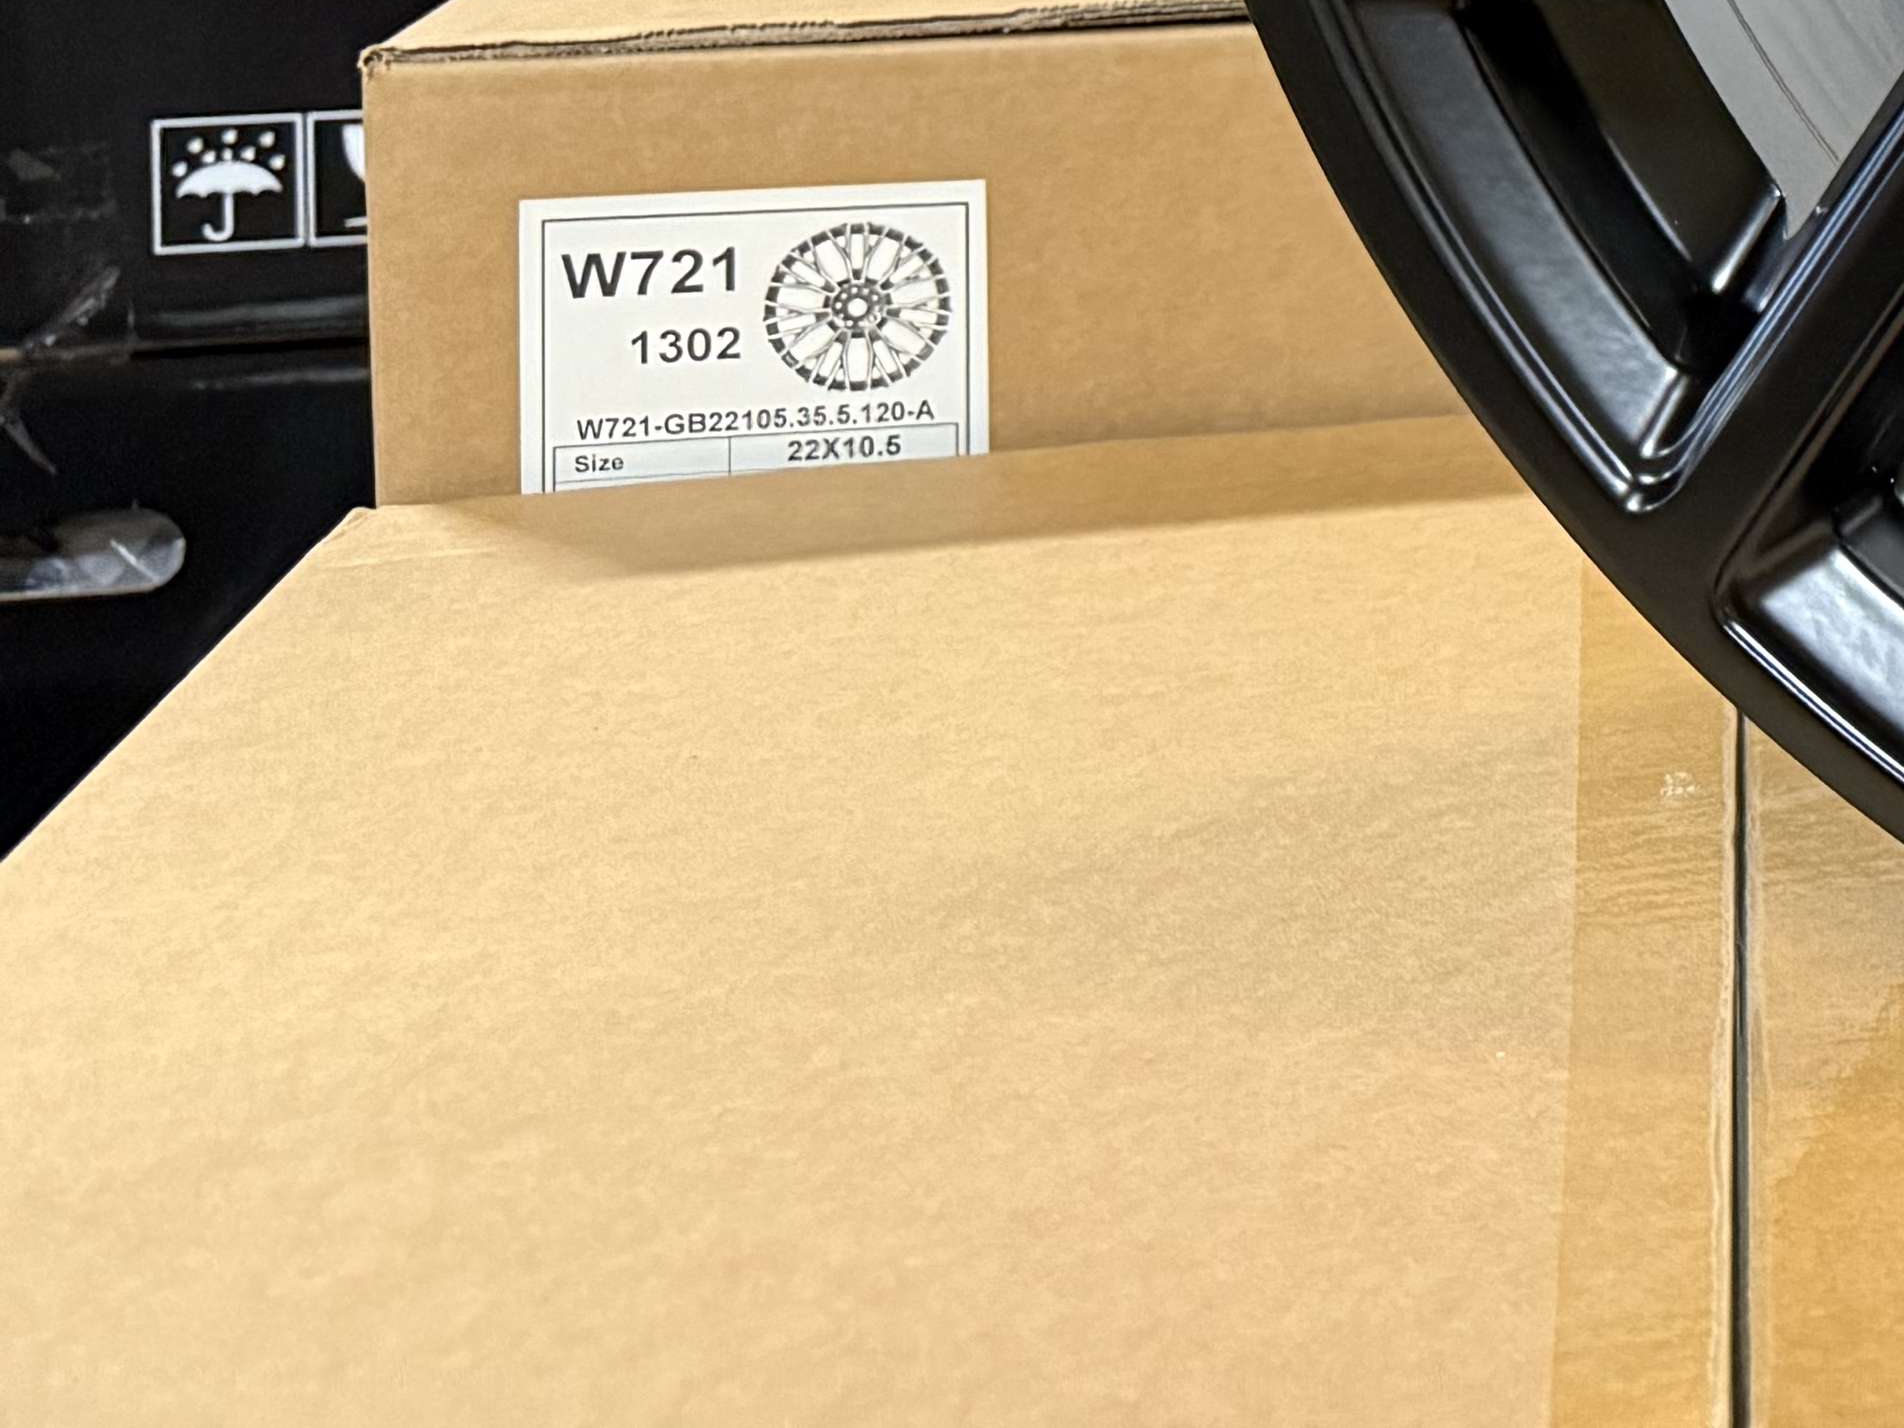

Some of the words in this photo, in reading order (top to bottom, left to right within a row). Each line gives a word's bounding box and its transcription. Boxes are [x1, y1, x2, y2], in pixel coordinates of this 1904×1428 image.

[561, 245, 737, 300] W721
[631, 326, 742, 365] 1302
[576, 400, 935, 441] W721-GB22105.35.5.120-A
[574, 453, 625, 474] Size
[786, 433, 902, 463] 22X10.5
